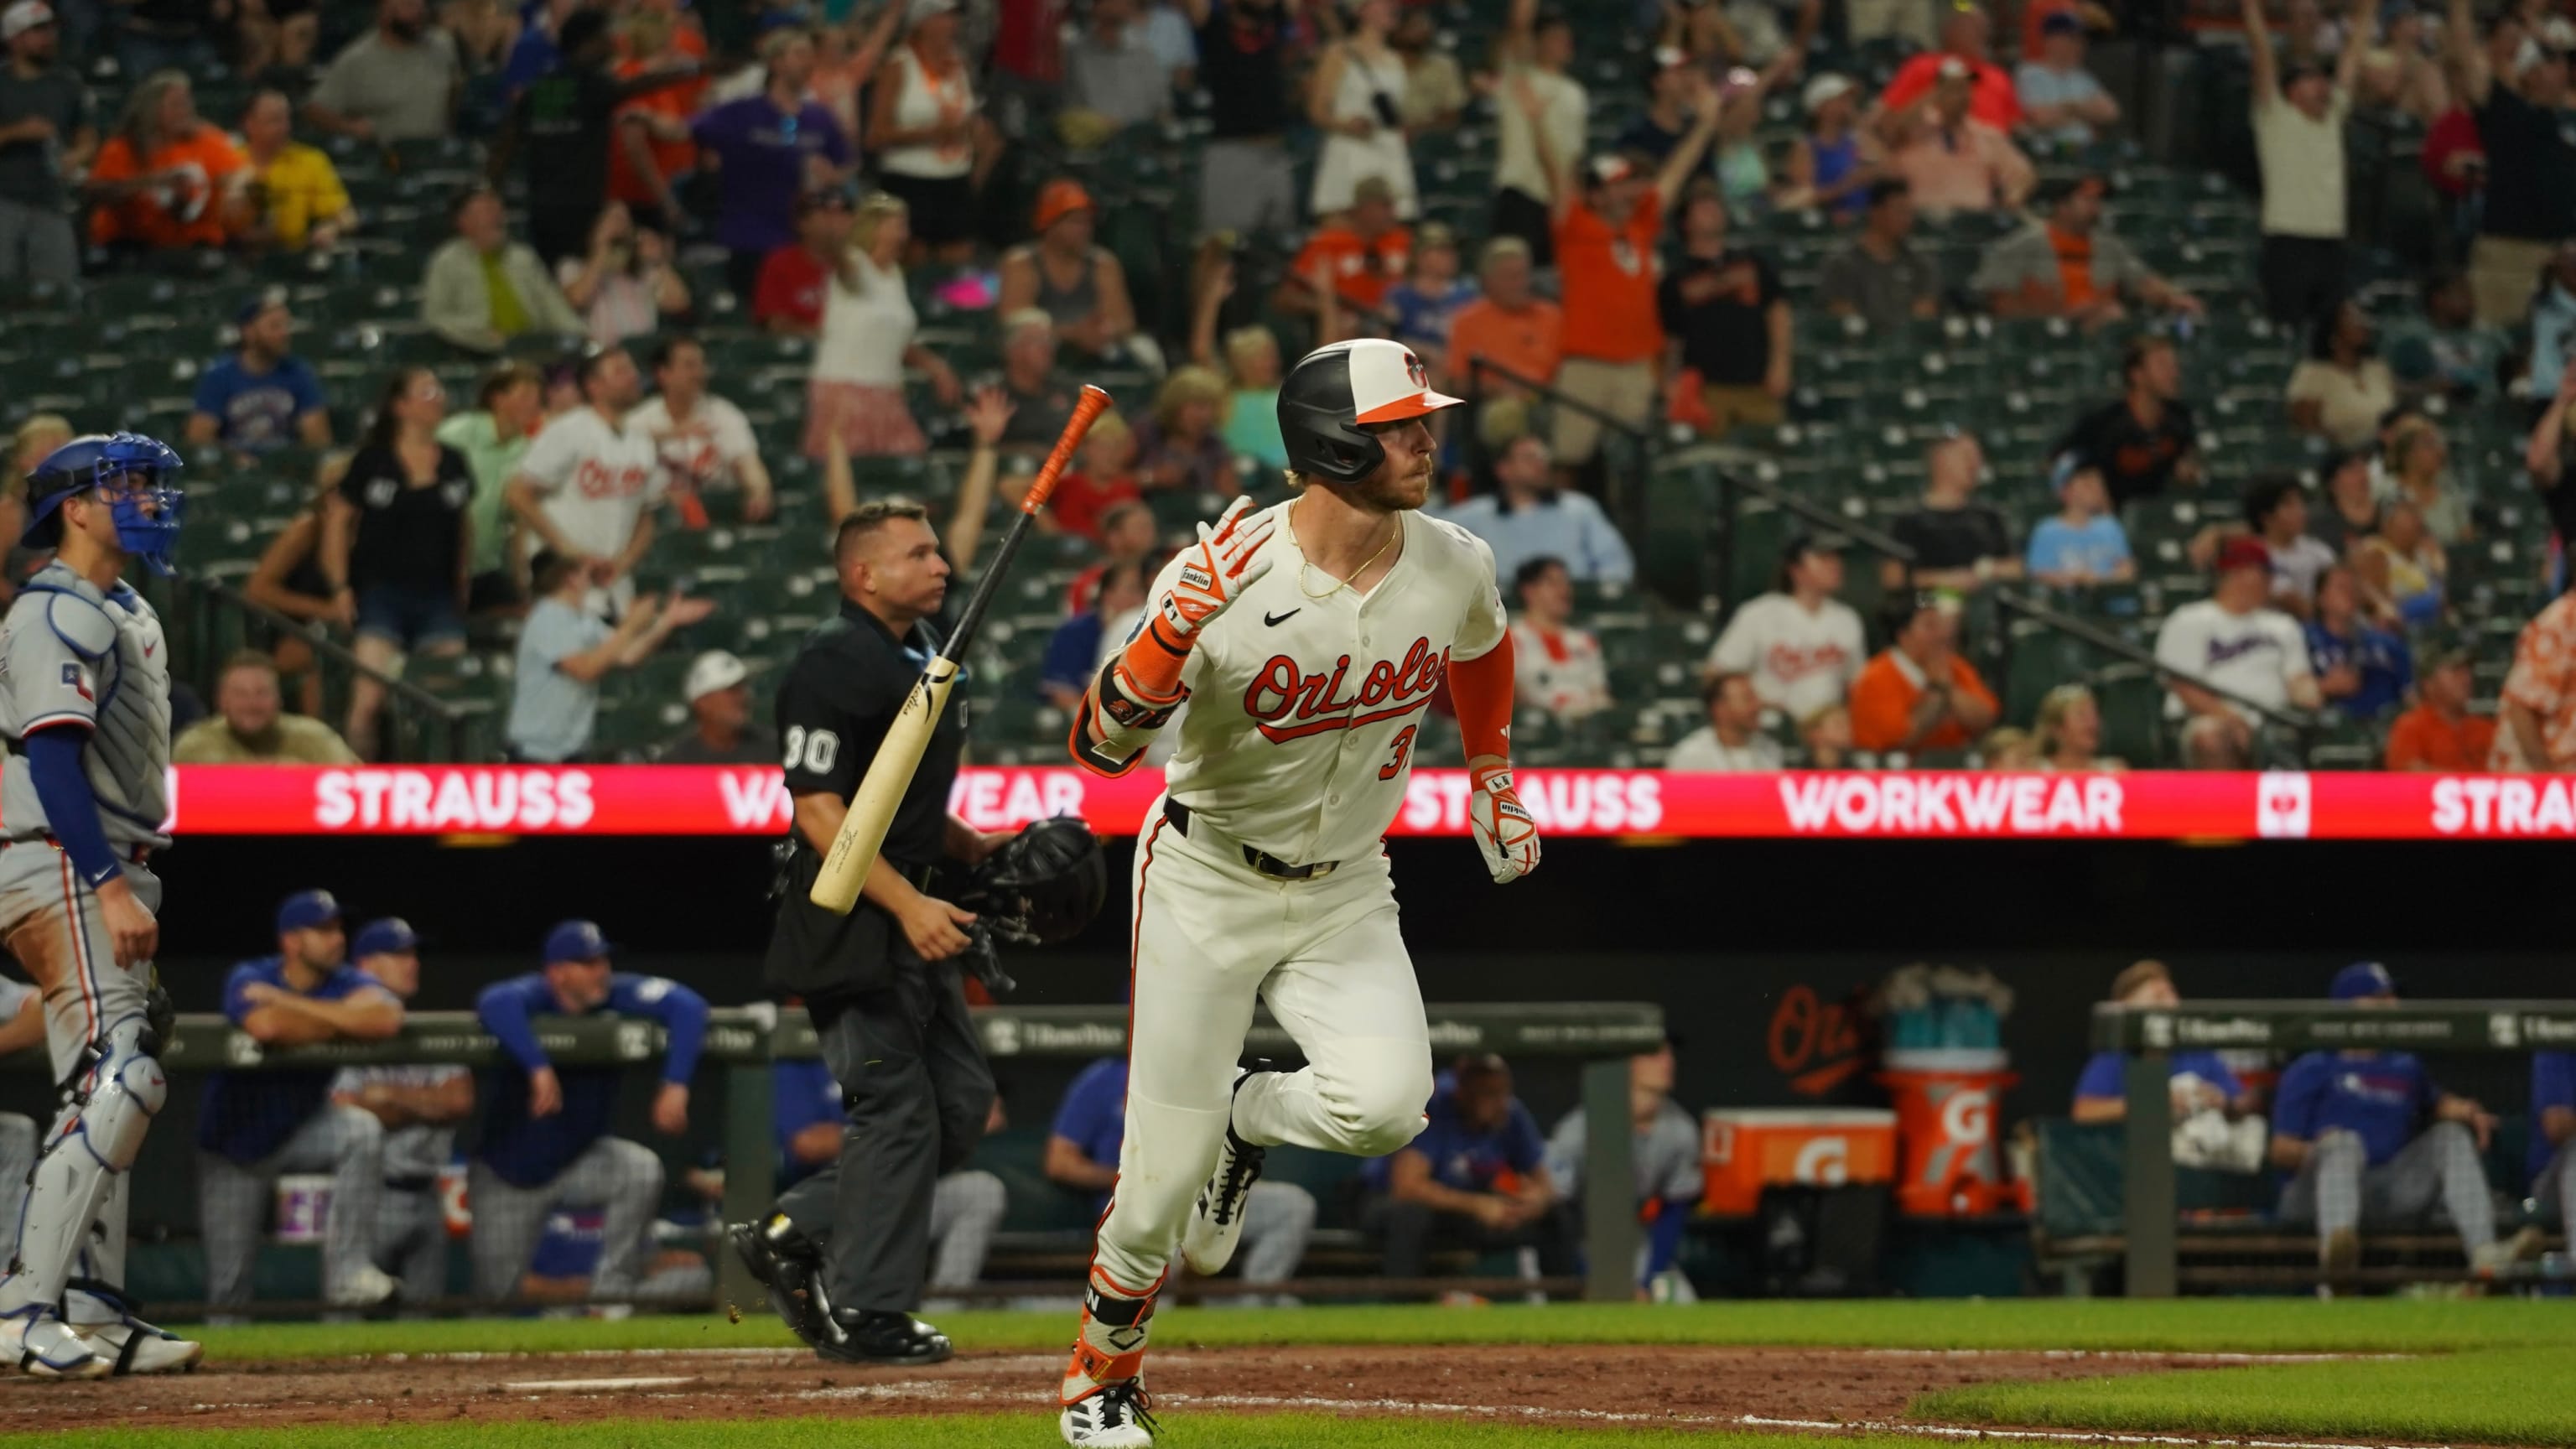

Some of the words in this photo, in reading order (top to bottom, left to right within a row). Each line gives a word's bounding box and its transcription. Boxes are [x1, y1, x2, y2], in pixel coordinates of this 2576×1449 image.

[1378, 724, 1416, 781] 3
[315, 772, 594, 827] STRAUSS
[1404, 774, 1663, 833] STAUSS
[1779, 776, 2123, 831] WORKWEAR
[2431, 776, 2576, 832] STRA
